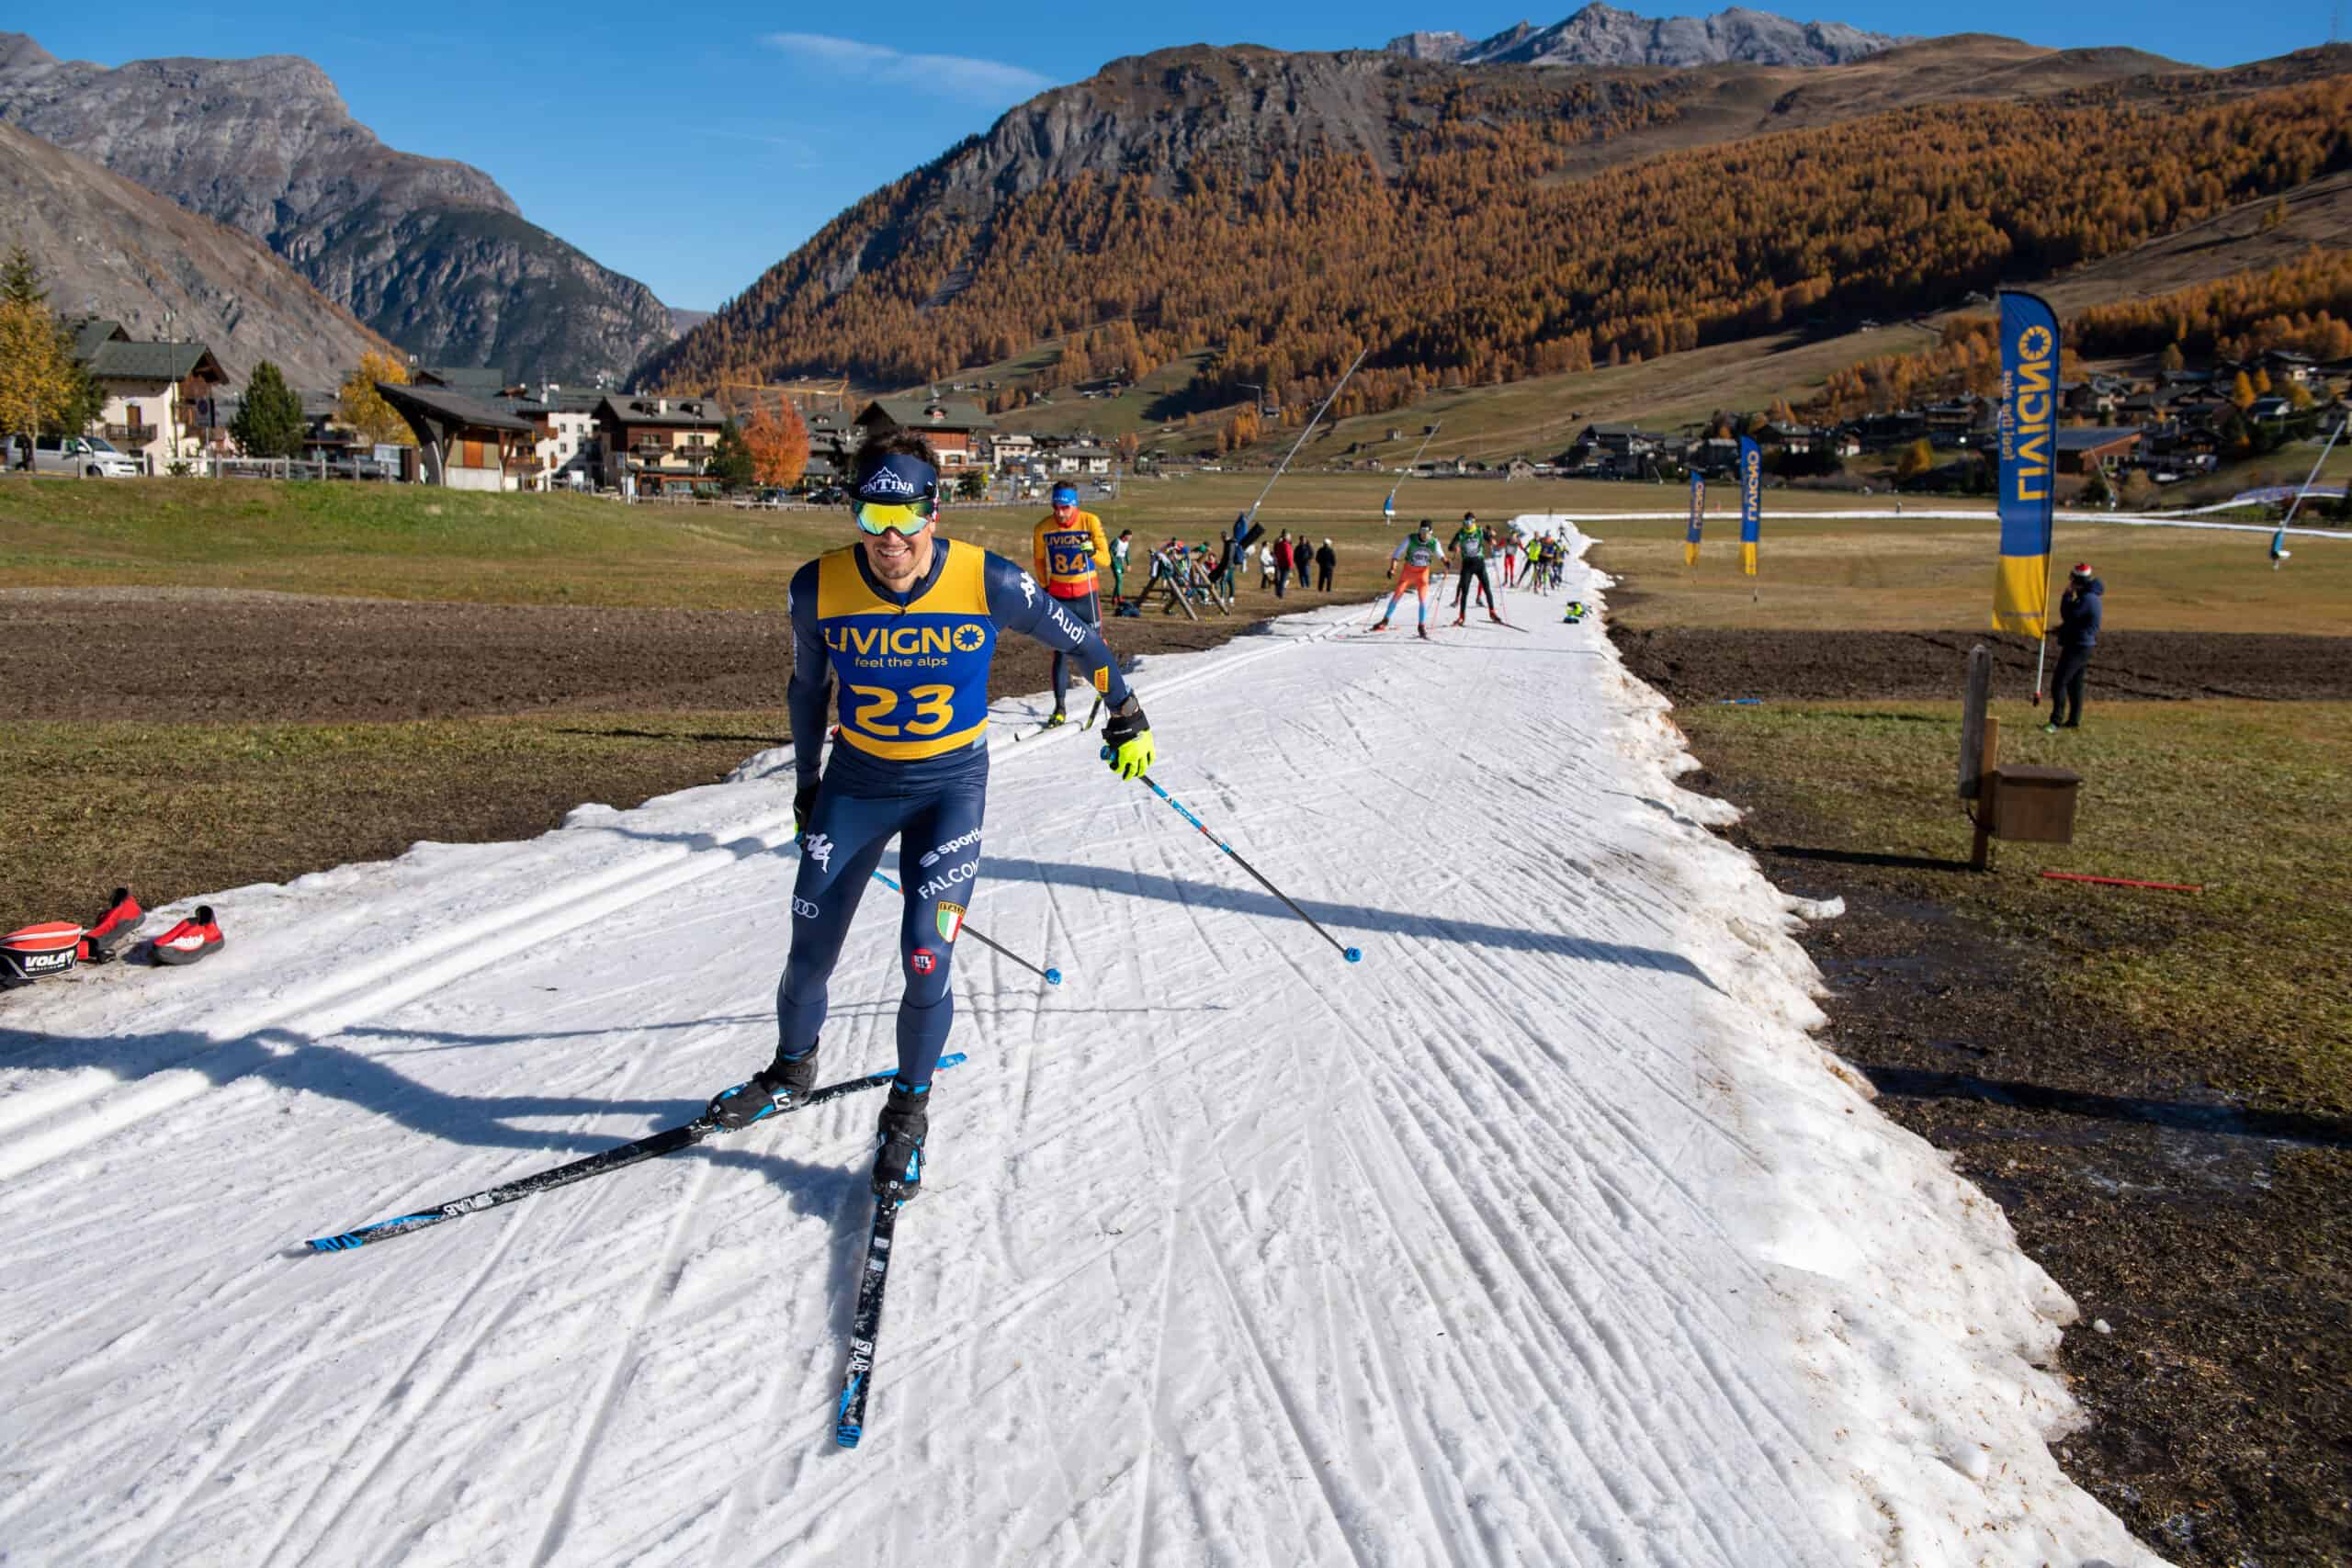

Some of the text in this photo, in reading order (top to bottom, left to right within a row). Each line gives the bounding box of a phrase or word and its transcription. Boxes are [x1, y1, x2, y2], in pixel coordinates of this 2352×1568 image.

[1044, 535, 1081, 545] LIVIGN
[1055, 553, 1086, 573] 84
[1052, 606, 1086, 645] Audi
[824, 624, 985, 655] LIVIGNO
[854, 656, 948, 669] feel the alps
[849, 683, 956, 736] 23
[25, 953, 66, 967] VOLA
